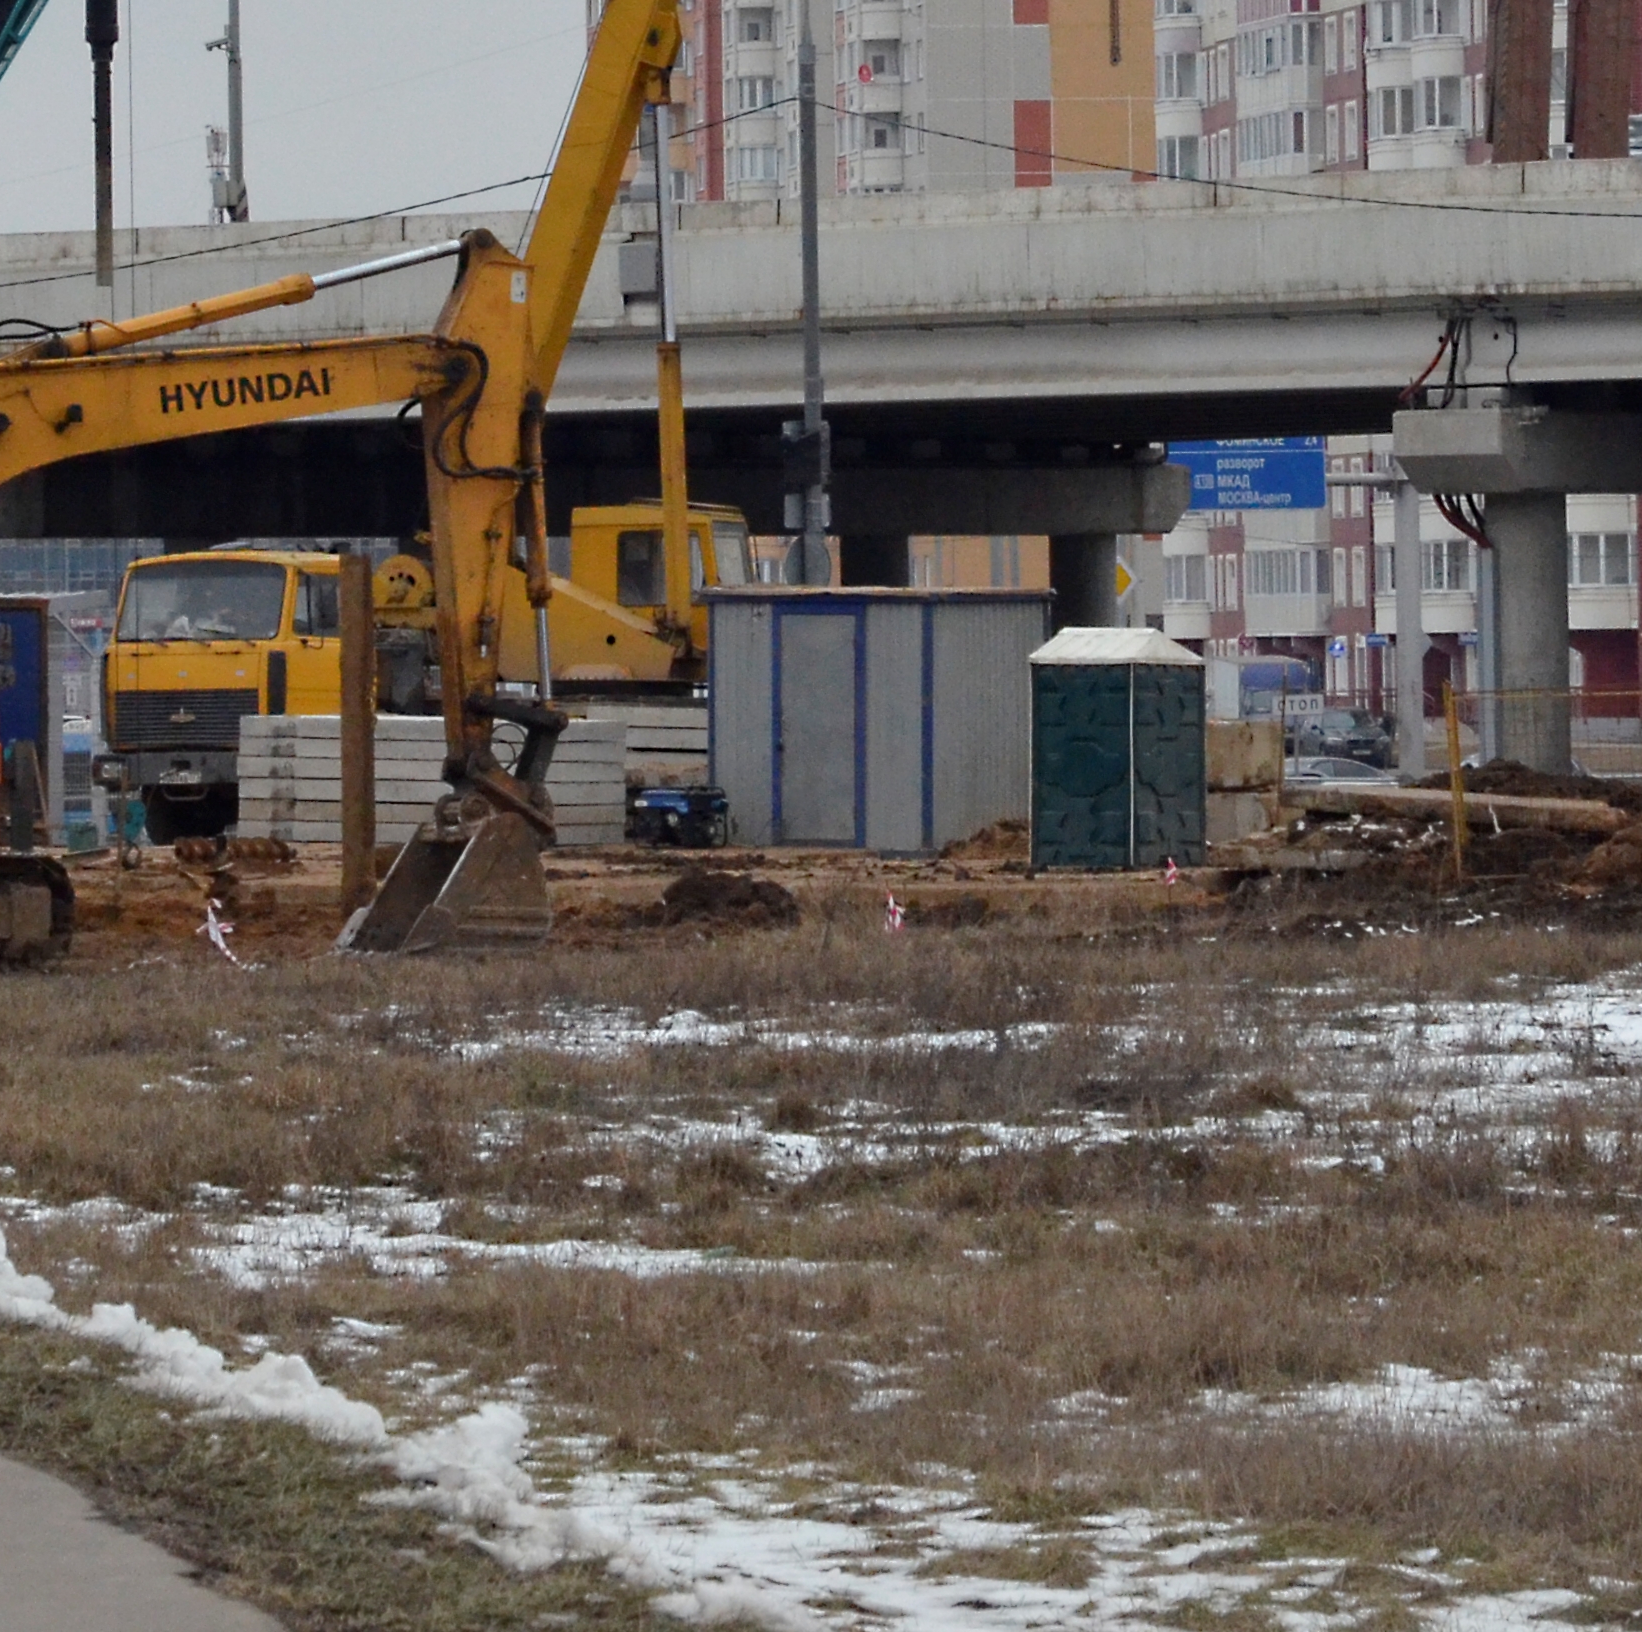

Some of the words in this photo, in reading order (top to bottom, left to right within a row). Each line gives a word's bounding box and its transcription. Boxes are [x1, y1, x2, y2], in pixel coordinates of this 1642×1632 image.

[159, 367, 331, 413] HYUNDAI
[1217, 458, 1265, 471] разворот
[1217, 474, 1250, 489] МКАД
[1278, 698, 1319, 711] СТОП
